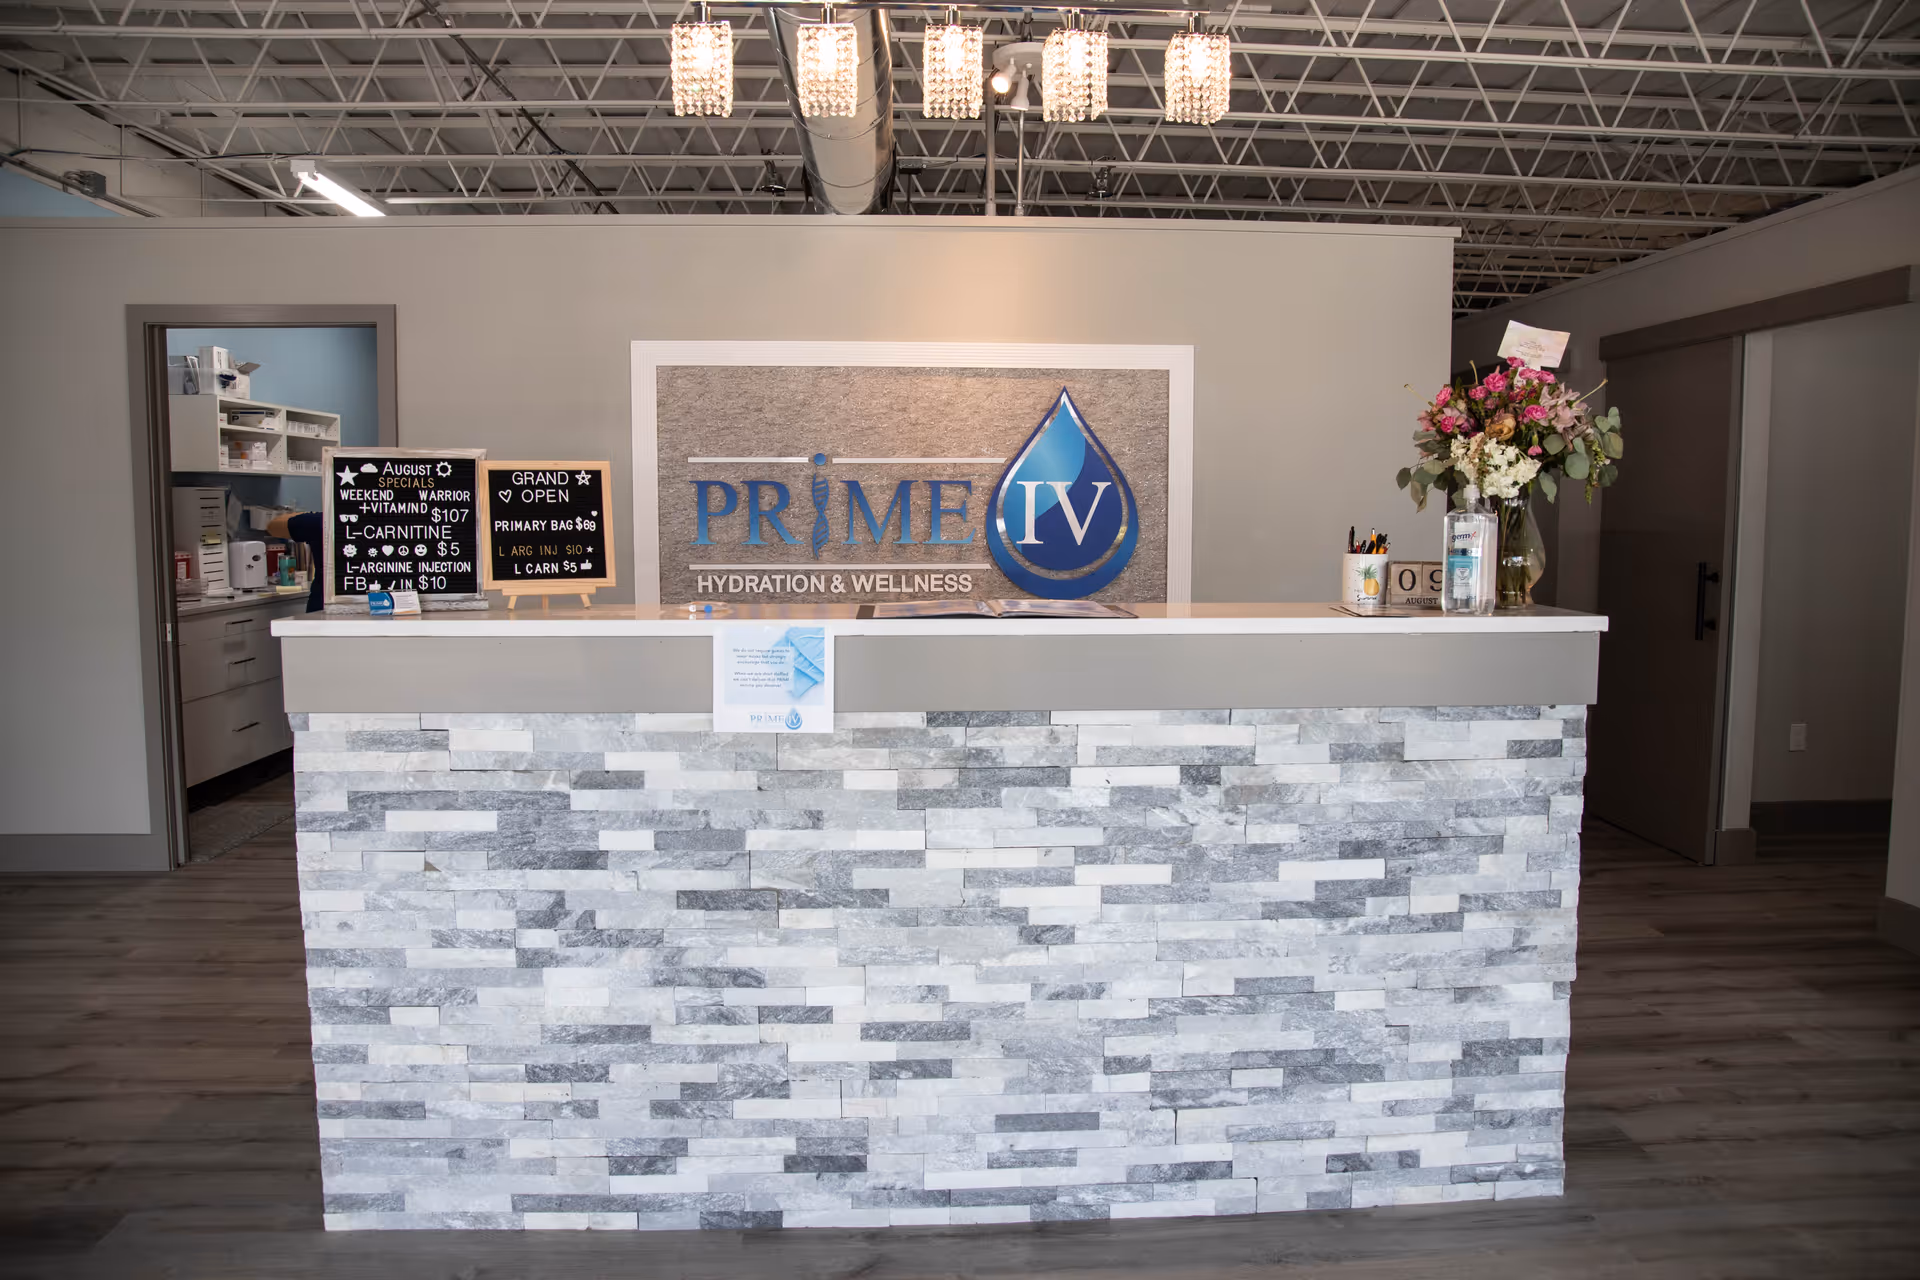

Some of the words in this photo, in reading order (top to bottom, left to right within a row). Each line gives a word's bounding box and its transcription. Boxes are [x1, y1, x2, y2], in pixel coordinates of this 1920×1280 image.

[382, 461, 432, 476] AUGUST
[378, 477, 435, 488] SPECIALS
[512, 471, 569, 485] GRAND
[340, 489, 394, 501] WEEKEND
[418, 489, 471, 502] WARRIOR
[521, 489, 569, 503] OPEN
[689, 453, 977, 560] PRIME
[1016, 481, 1112, 545] IV
[431, 507, 469, 523] $107
[494, 520, 547, 532] PRIMARY
[550, 519, 574, 531] BAG
[575, 516, 596, 532] $69
[346, 525, 452, 539] L-CARNITINE
[437, 540, 460, 557] $5
[498, 546, 505, 557] L
[511, 545, 533, 556] ARG
[539, 545, 558, 556] INJ
[346, 561, 413, 573] L-ARGININE
[418, 561, 471, 573] INJECTION
[514, 563, 521, 575] L
[525, 562, 559, 574] CARN
[563, 560, 578, 573] $5
[344, 576, 367, 591] FB
[400, 579, 413, 591] IN
[418, 574, 447, 591] $10
[698, 574, 827, 594] HYDRATION
[830, 574, 846, 594] &
[851, 573, 973, 594] WELLNESS
[1405, 597, 1439, 605] AUGUST
